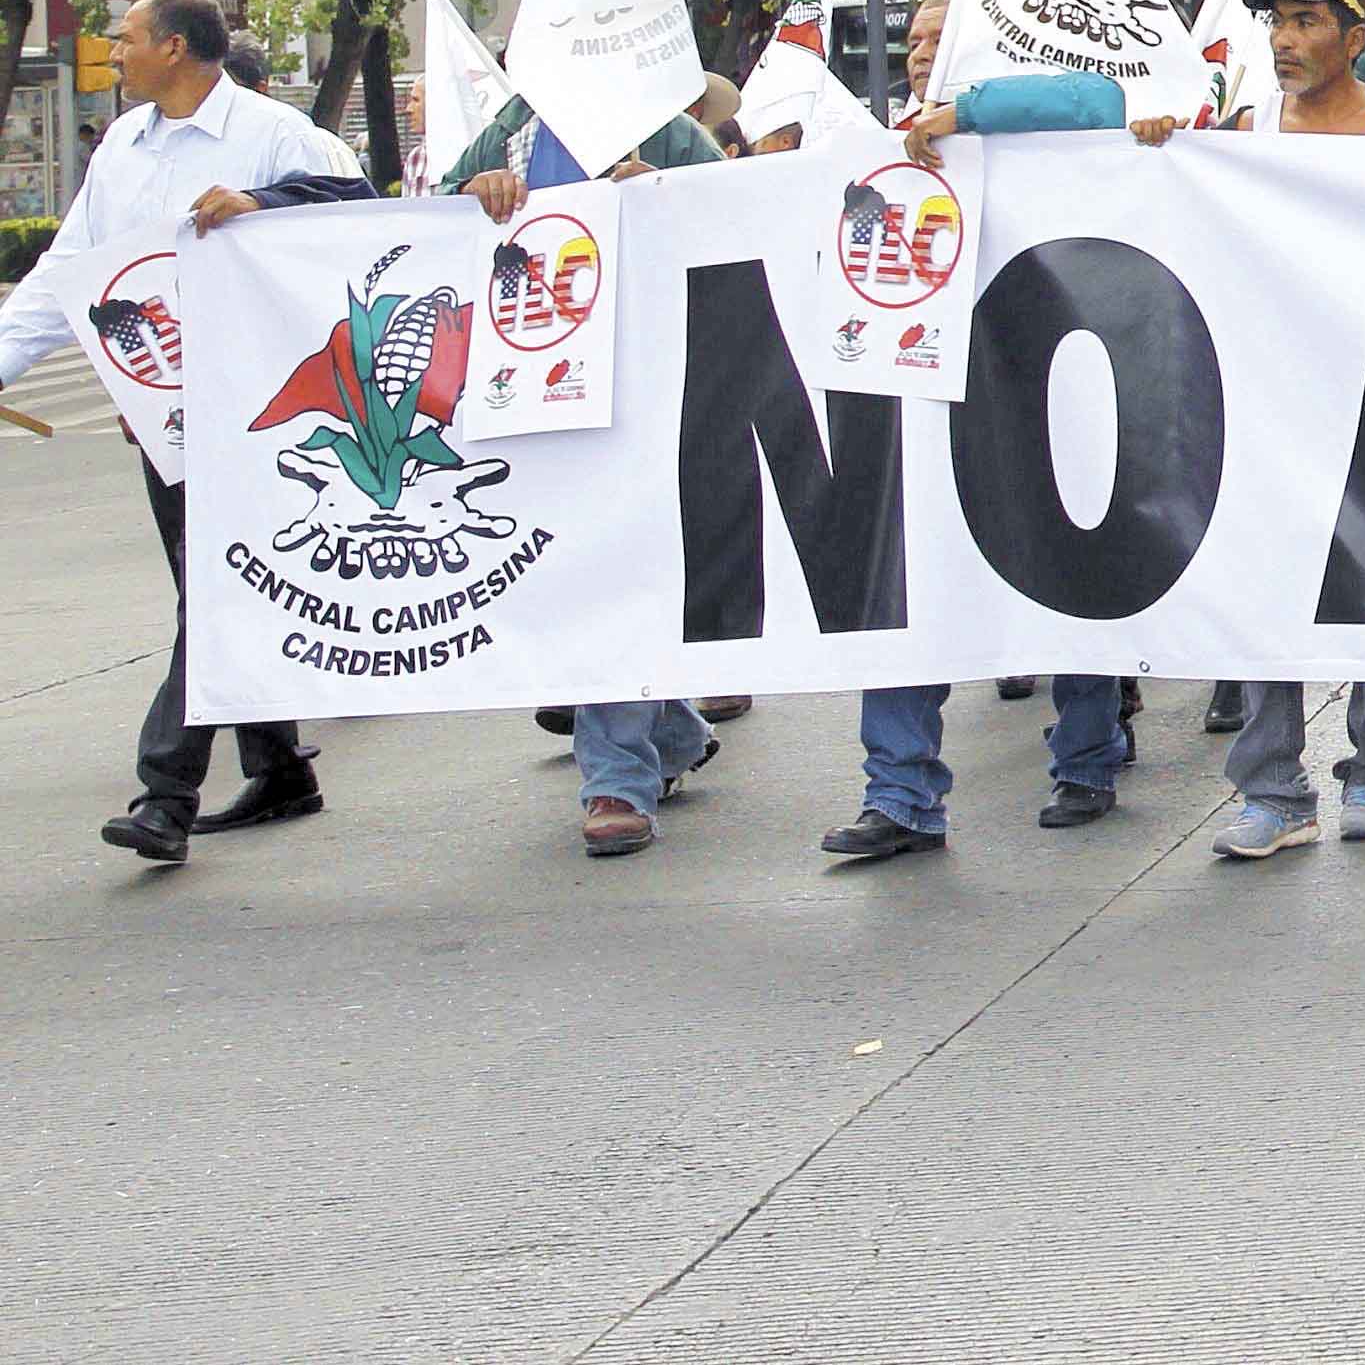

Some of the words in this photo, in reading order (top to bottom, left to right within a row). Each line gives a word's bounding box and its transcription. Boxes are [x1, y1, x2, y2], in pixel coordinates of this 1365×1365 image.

[1039, 43, 1151, 78] CAMPESINA
[679, 236, 1226, 644] NO
[224, 539, 364, 634] CENTRAL
[370, 525, 556, 636] CAMPESINA
[280, 623, 495, 677] CARDENISTA
